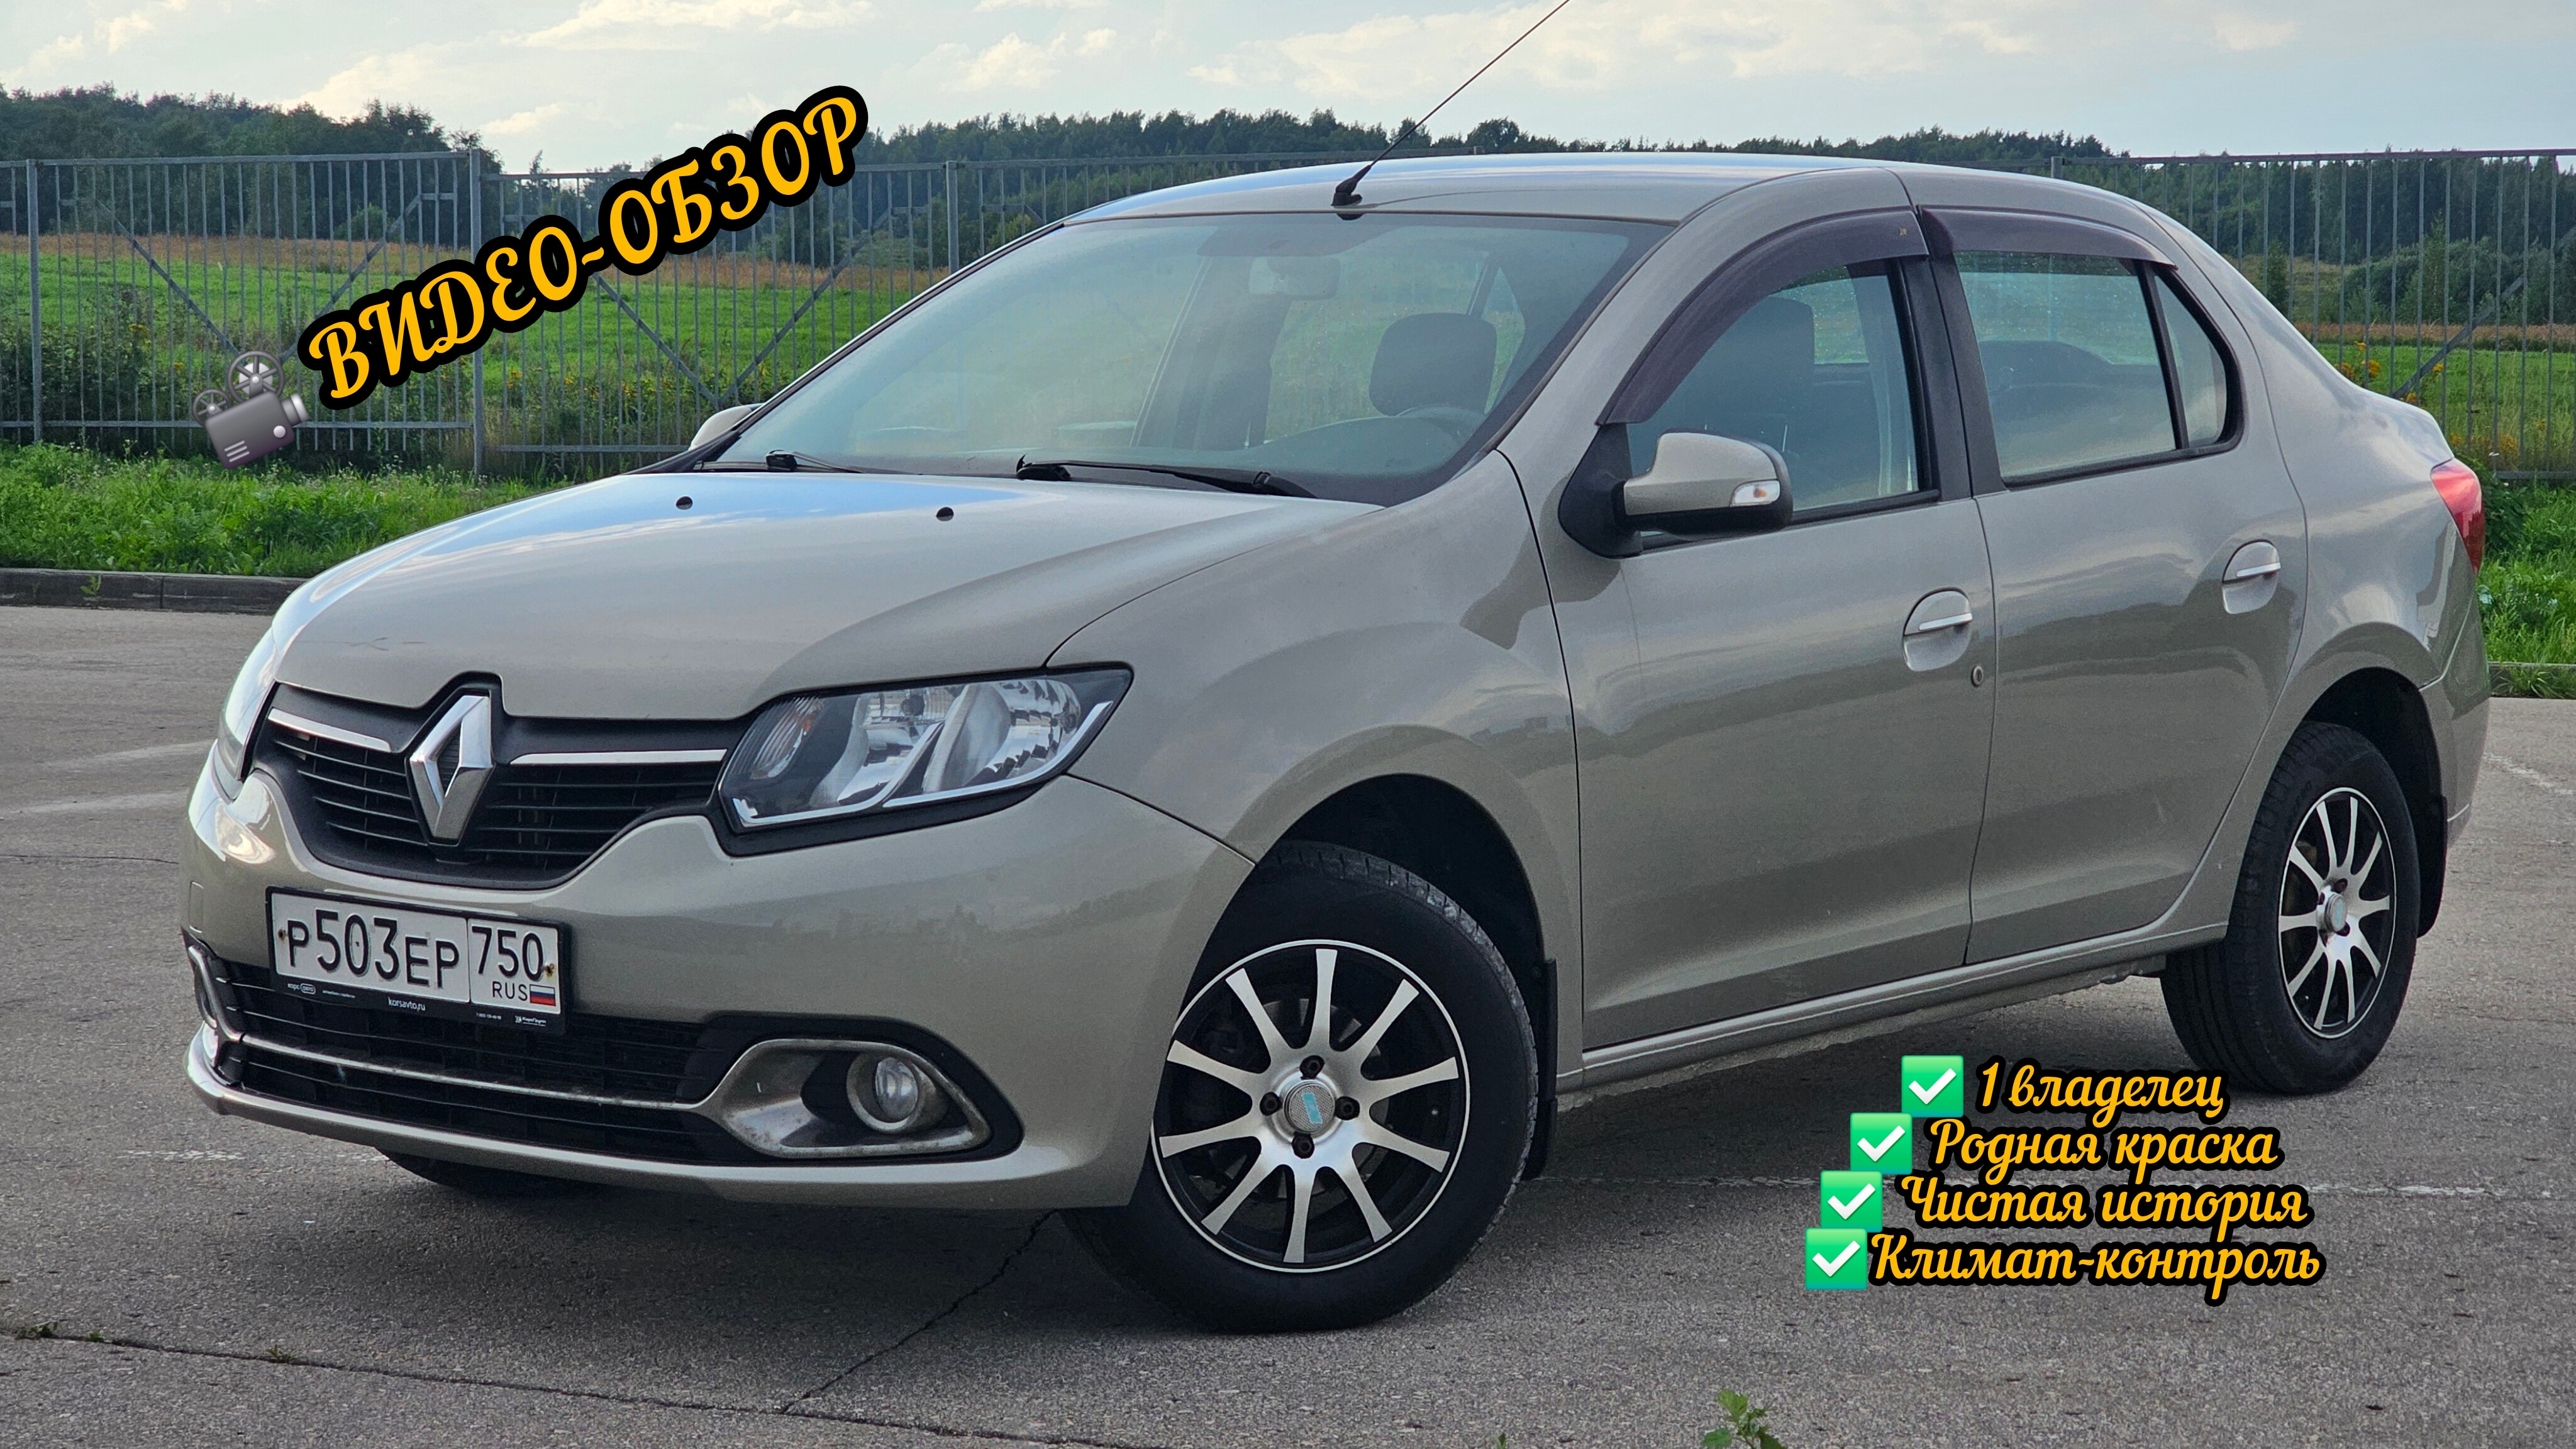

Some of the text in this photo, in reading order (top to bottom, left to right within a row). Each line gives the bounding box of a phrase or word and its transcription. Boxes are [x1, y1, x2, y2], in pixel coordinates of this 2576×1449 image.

[471, 926, 544, 981] 750
[492, 981, 528, 1001] RUS
[388, 996, 426, 1011] korsavto.ru
